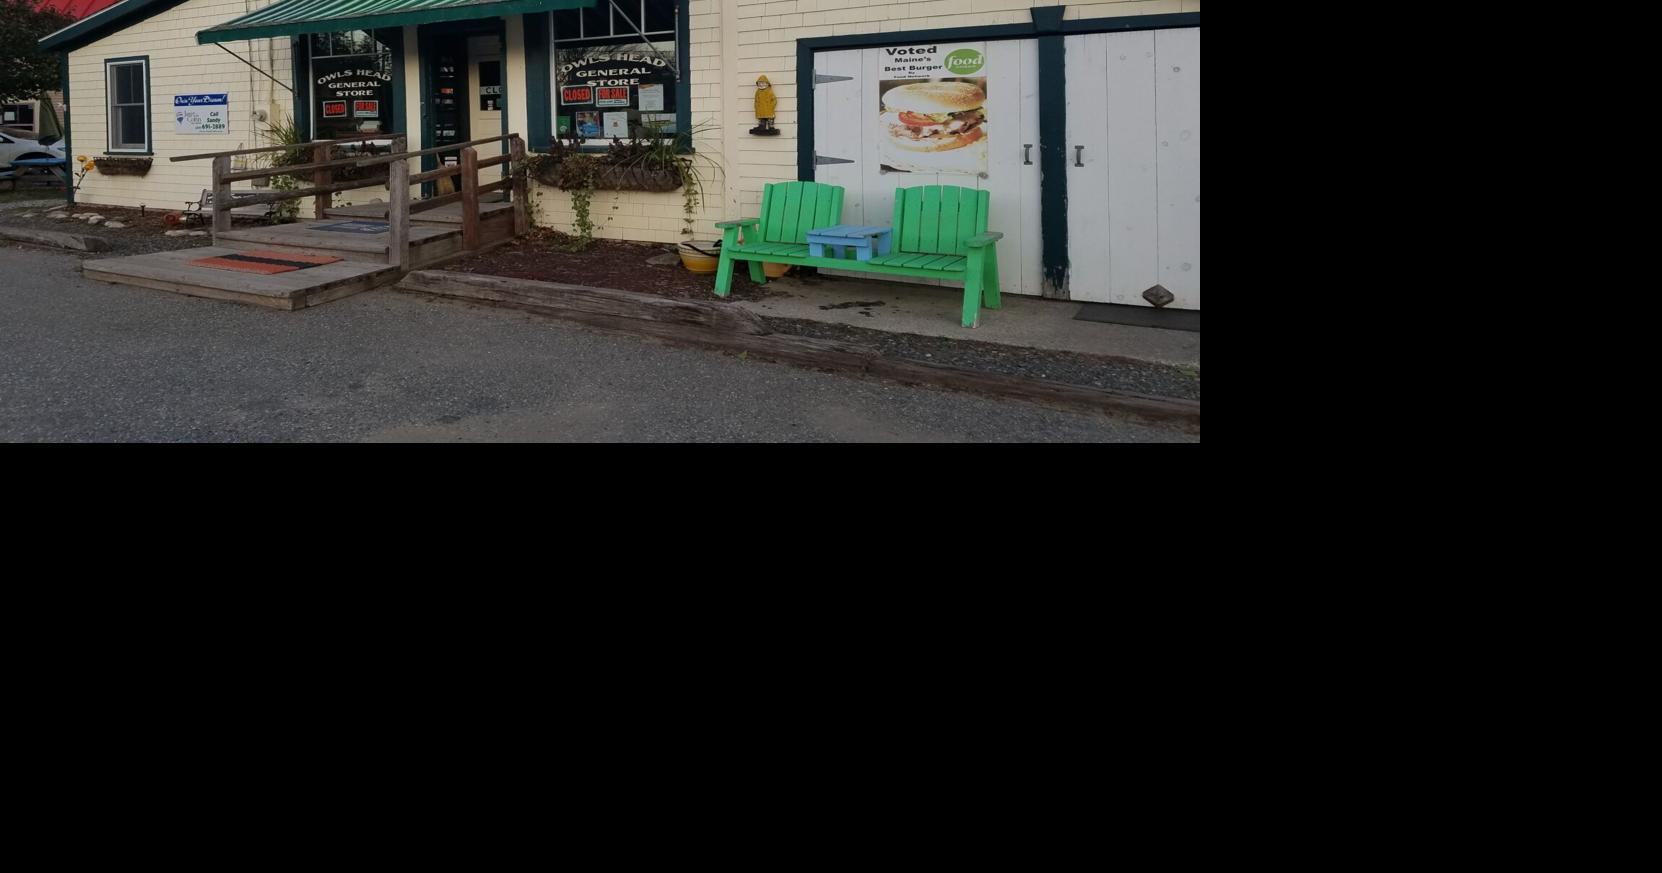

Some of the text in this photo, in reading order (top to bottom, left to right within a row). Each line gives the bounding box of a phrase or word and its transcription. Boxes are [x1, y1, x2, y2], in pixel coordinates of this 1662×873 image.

[886, 46, 937, 56] Voted
[561, 53, 666, 73] OWLS HEAD
[947, 54, 983, 70] food
[576, 68, 651, 77] GENERAL
[909, 64, 943, 72] Burger
[318, 69, 391, 85] OWLS HEAD
[586, 78, 640, 87] STORE
[563, 88, 591, 101] CLOSED
[599, 88, 610, 99] FOR
[611, 87, 627, 99] SALE
[325, 103, 344, 114] CLOSED
